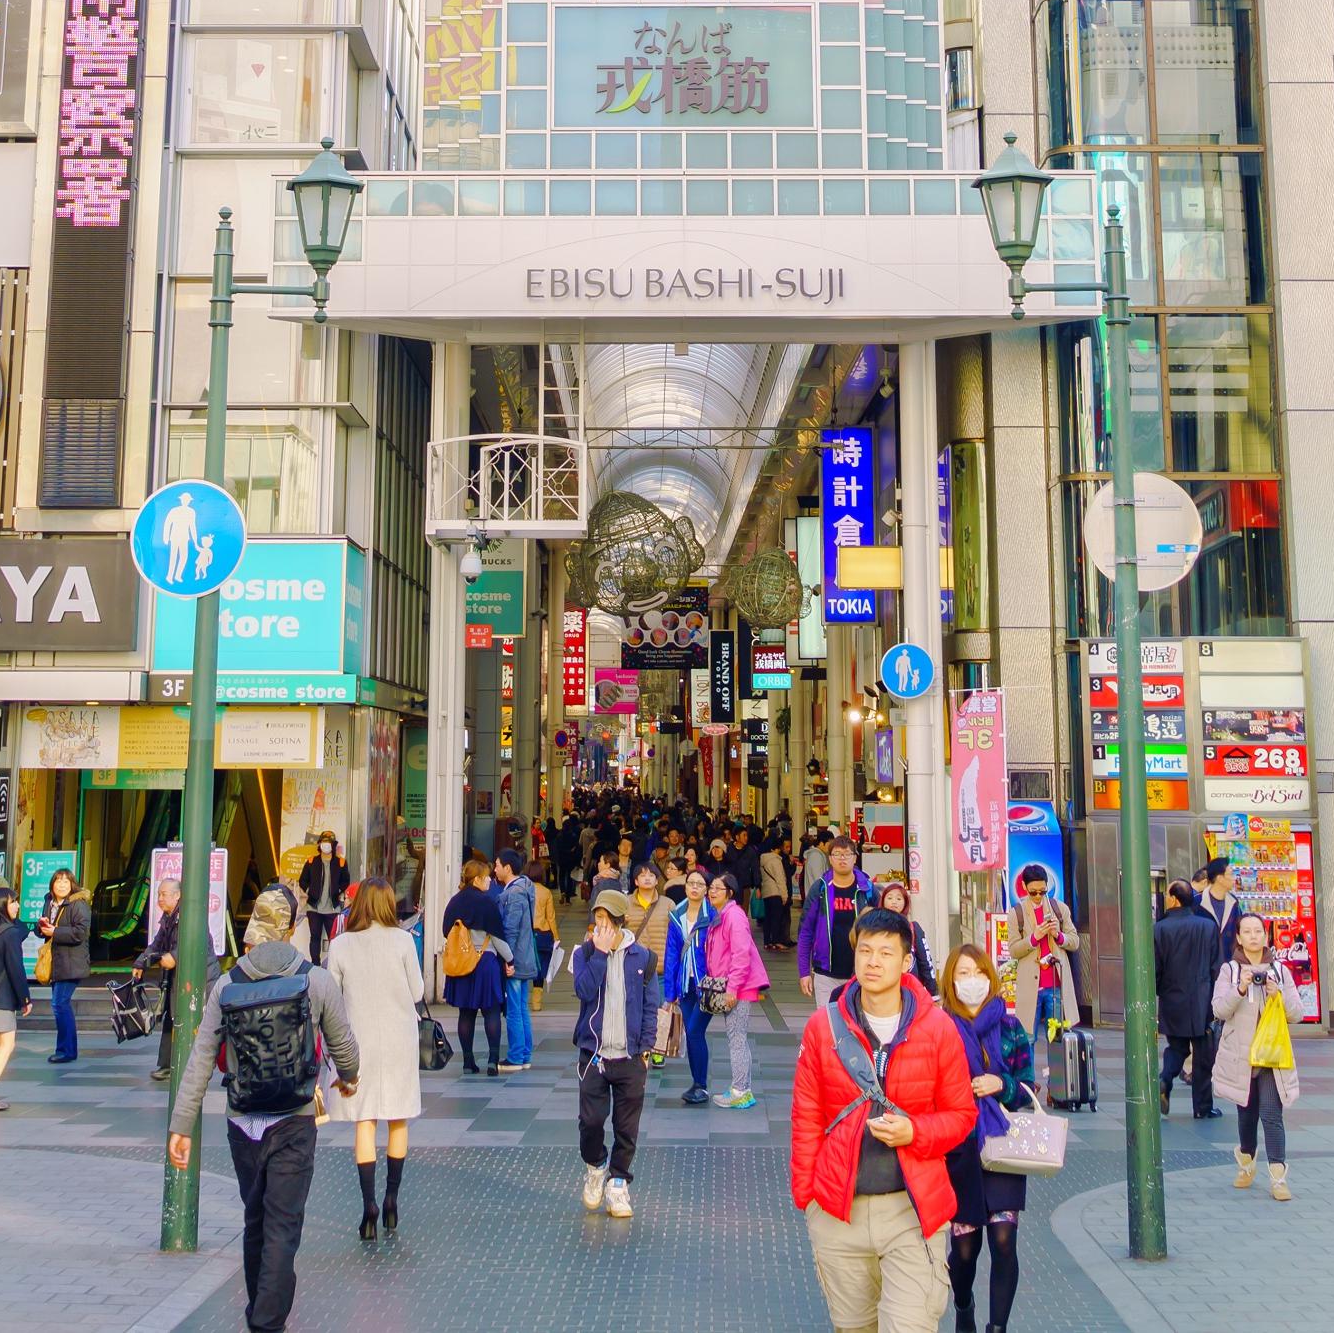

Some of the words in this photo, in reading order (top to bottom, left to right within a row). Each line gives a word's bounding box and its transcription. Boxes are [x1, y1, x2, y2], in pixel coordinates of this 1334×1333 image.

[632, 19, 733, 56] なんば
[595, 55, 770, 116] 戎橋筋
[525, 266, 634, 301] EBISU
[830, 437, 865, 547] 時計倉
[466, 603, 503, 615] store
[827, 598, 873, 615] TOKIA
[1090, 643, 1098, 655] 4
[1201, 643, 1211, 655] 8
[721, 642, 730, 685] BRAND
[758, 676, 790, 687] ORBIS
[1092, 679, 1101, 690] 3
[162, 679, 185, 697] 3F
[295, 682, 347, 699] store
[721, 687, 730, 712] OFF
[1093, 713, 1102, 724] 2
[1204, 714, 1213, 724] 6
[269, 737, 302, 745] SOFINA
[1096, 747, 1103, 758] 1
[1206, 746, 1215, 758] 5
[1253, 748, 1301, 769] 268
[98, 770, 112, 781] 3F
[1009, 825, 1049, 834] pepsi
[25, 857, 44, 877] 3F
